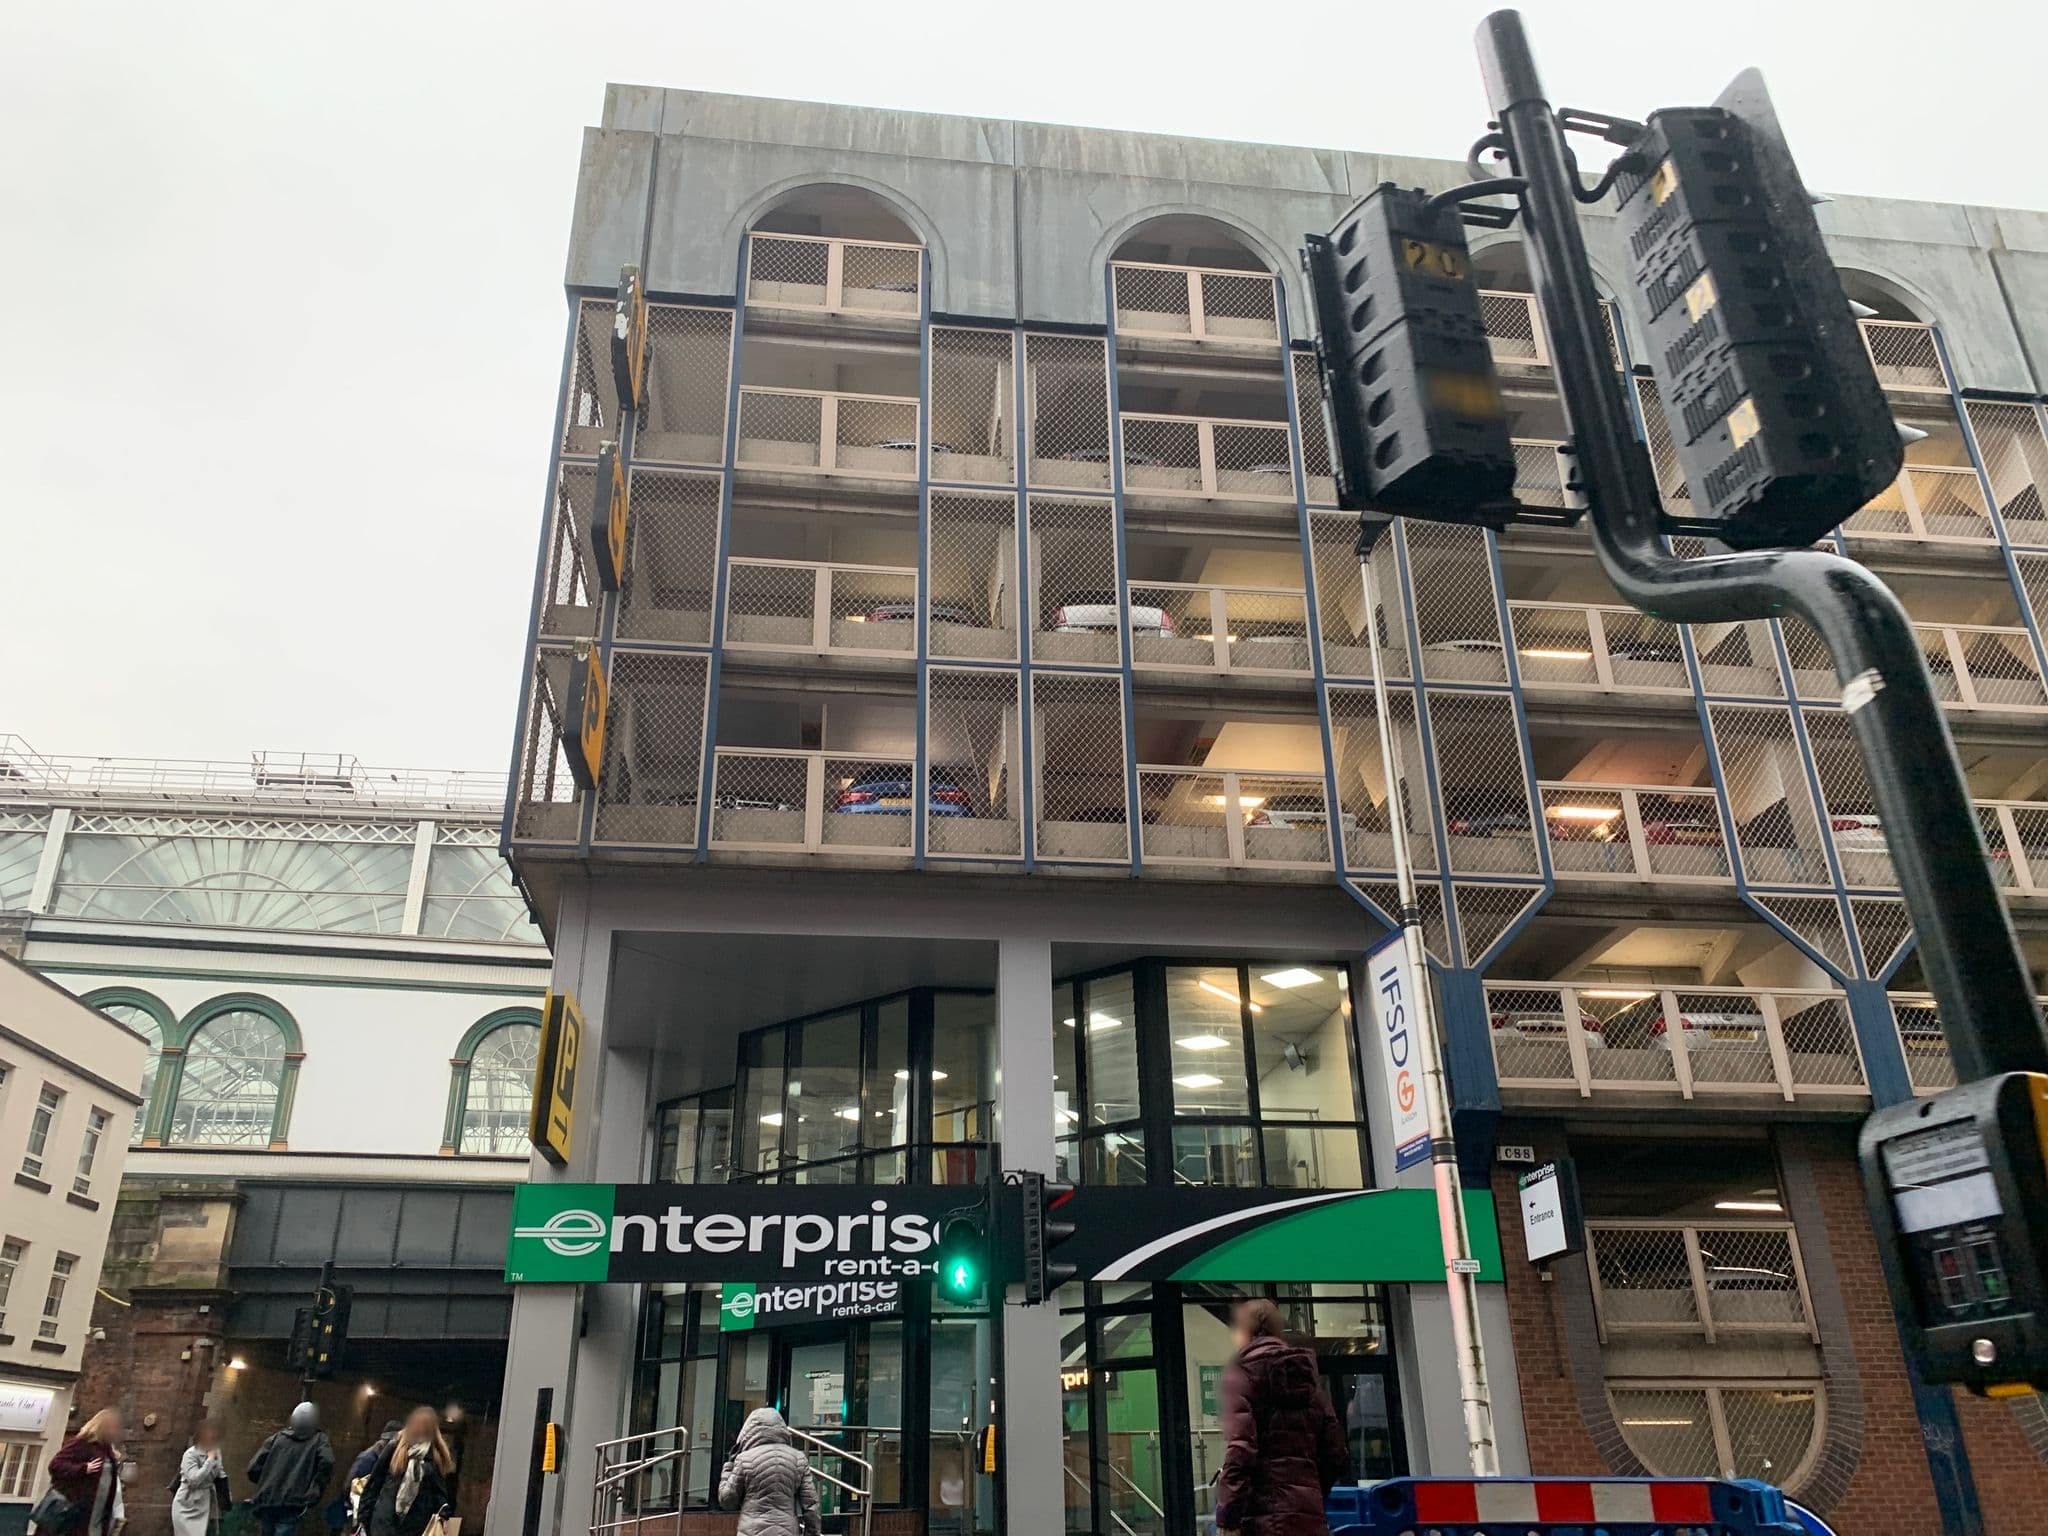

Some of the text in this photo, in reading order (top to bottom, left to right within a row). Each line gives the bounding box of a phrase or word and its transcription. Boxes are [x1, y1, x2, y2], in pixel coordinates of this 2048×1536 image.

[1379, 966, 1408, 1068] IFSD
[1518, 1163, 1555, 1186] enterprise
[1530, 1209, 1554, 1225] Entrance
[514, 1200, 940, 1268] enterpris
[511, 1272, 524, 1281] TM
[721, 1281, 898, 1318] enterprise
[832, 1299, 898, 1318] rent-a-car
